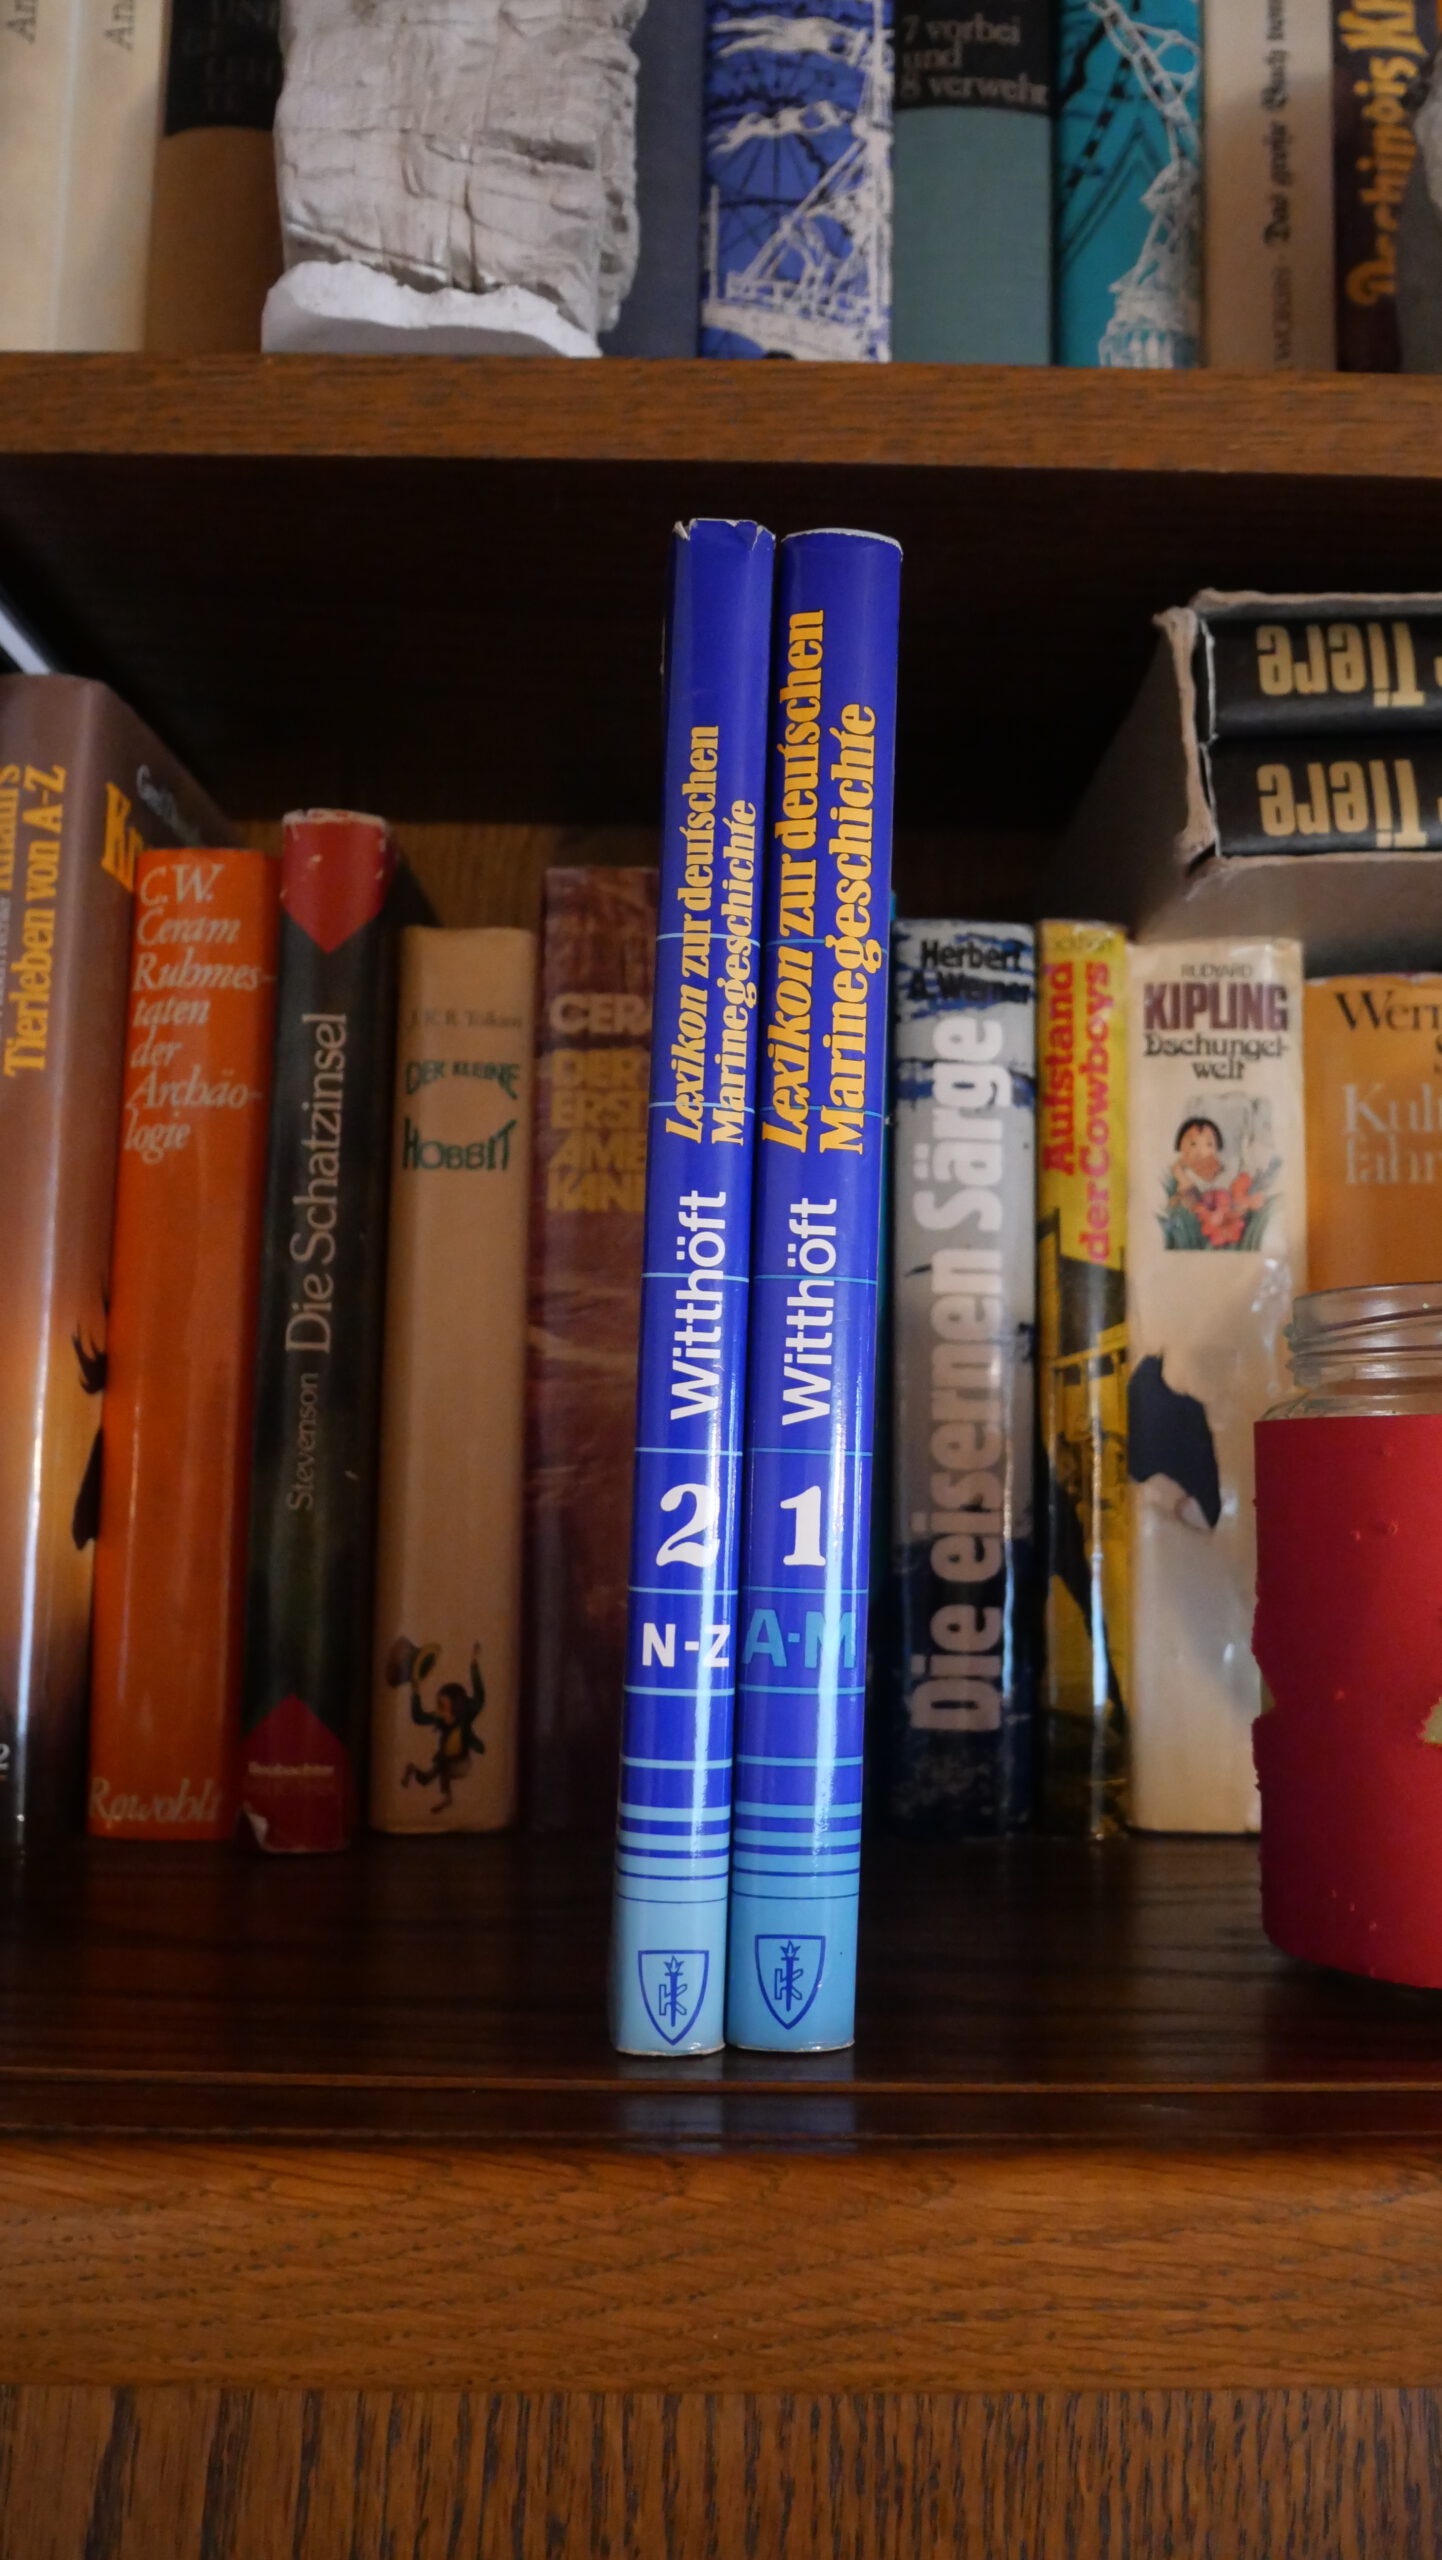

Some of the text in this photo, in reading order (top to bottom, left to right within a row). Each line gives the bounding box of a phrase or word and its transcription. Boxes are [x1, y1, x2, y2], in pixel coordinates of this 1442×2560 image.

[1256, 620, 1425, 708] Tiere
[1256, 758, 1428, 849] Tiere
[24, 843, 60, 902] von
[762, 609, 824, 1154] Lexikon zur deutschen
[136, 907, 240, 948] Ceram
[665, 724, 719, 1145] Lexikon zur deutschen
[819, 703, 883, 1156] Marinegeschichte
[920, 939, 1021, 972] Herbert
[4, 909, 56, 1076] Tierleben
[132, 996, 210, 1029] taten
[711, 799, 757, 1146] Marinegeschichte
[1144, 981, 1289, 1032] KIPLING
[130, 1024, 182, 1070] der
[1041, 960, 1076, 1176] Aufstand
[1078, 961, 1115, 1178] Cowboys
[1191, 1060, 1246, 1080] welt
[123, 1104, 192, 1166] logie
[402, 1117, 518, 1171] HOBBIT
[284, 1013, 348, 1512] Stevenson Die Schatzinsel
[670, 1189, 727, 1421] Witthöft
[782, 1197, 838, 1426] Witthöft
[909, 1016, 1014, 1734] Die eisernen Särge
[655, 1482, 721, 1568] 2
[779, 1484, 827, 1567] 1
[641, 1622, 731, 1668] N-Z
[741, 1608, 857, 1669] A-M
